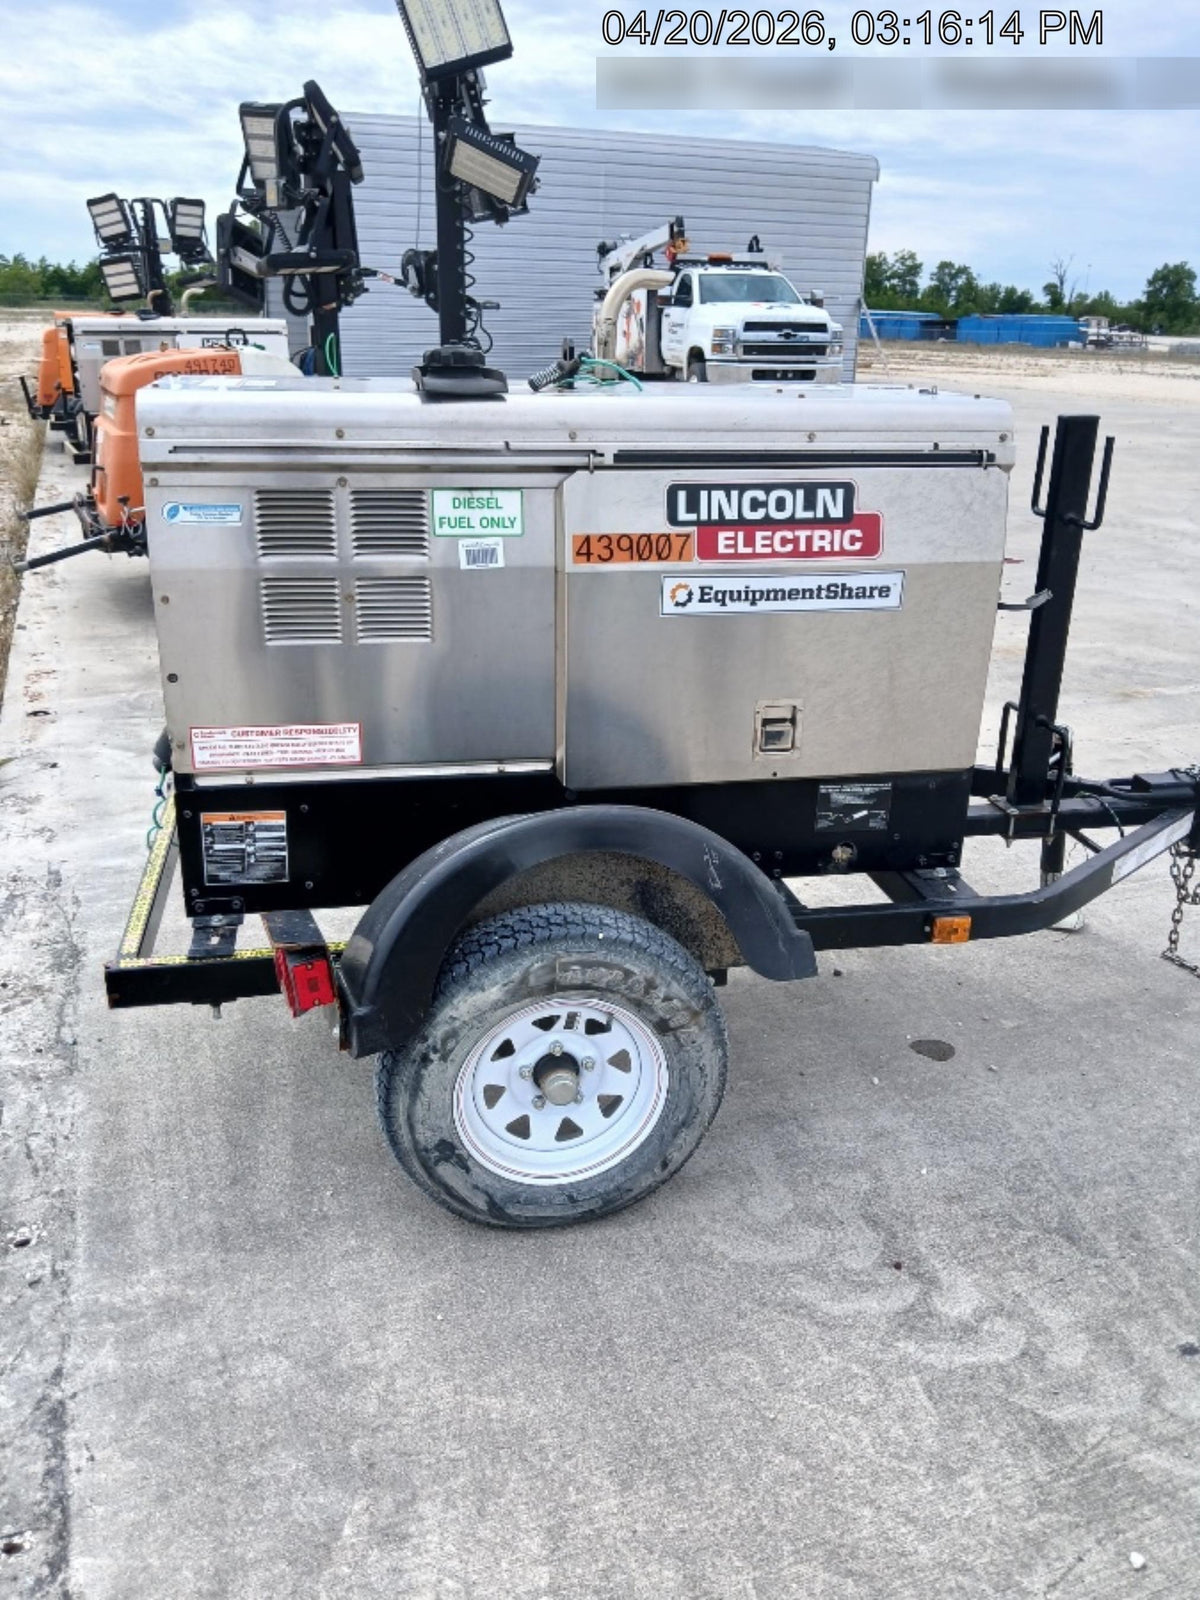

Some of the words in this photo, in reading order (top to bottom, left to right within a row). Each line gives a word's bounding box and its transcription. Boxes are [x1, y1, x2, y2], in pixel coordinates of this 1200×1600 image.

[185, 358, 235, 370] 491740
[452, 497, 503, 510] DIESEL
[676, 488, 845, 522] LINCOLN
[438, 516, 475, 529] FUEL
[479, 516, 517, 529] ONLY
[575, 532, 691, 563] 439007
[717, 529, 863, 554] ELECTRIC
[698, 583, 891, 606] EquipmentShare
